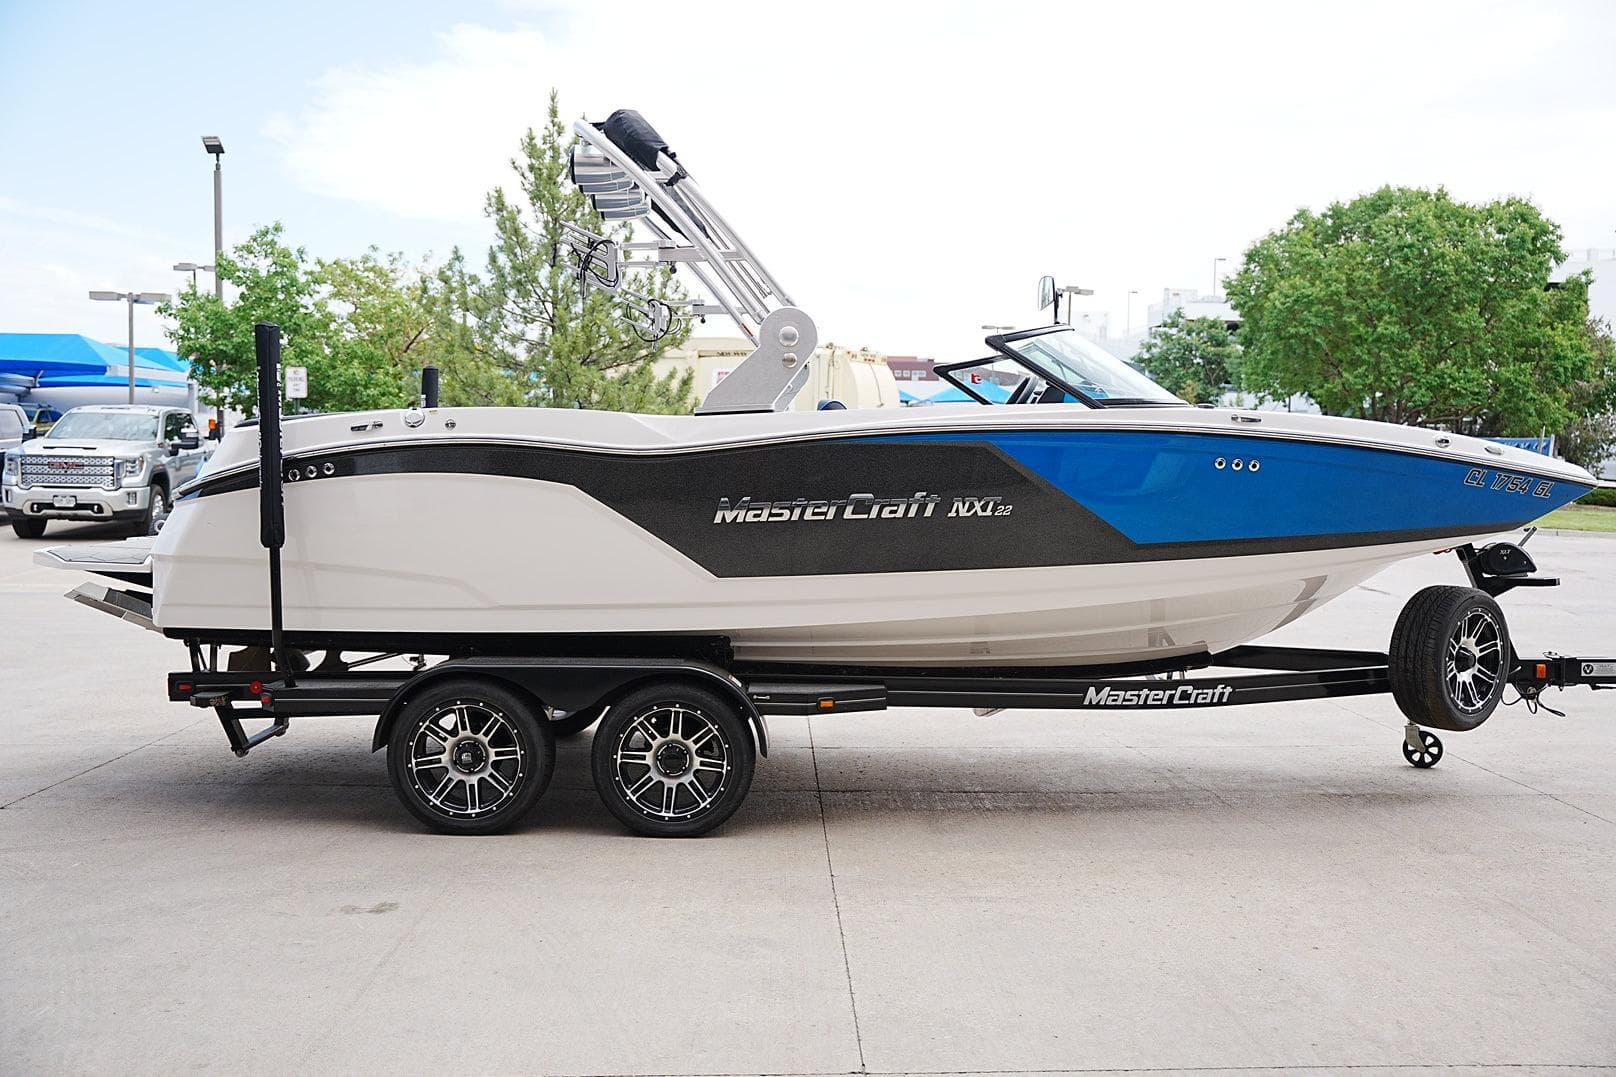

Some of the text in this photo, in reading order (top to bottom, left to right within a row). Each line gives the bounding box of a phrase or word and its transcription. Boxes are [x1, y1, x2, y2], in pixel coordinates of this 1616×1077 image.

[1464, 468, 1554, 498] CL 1754 GL
[713, 492, 1013, 524] MasterCraft NXT 22
[1083, 684, 1233, 705] MasterCraft
